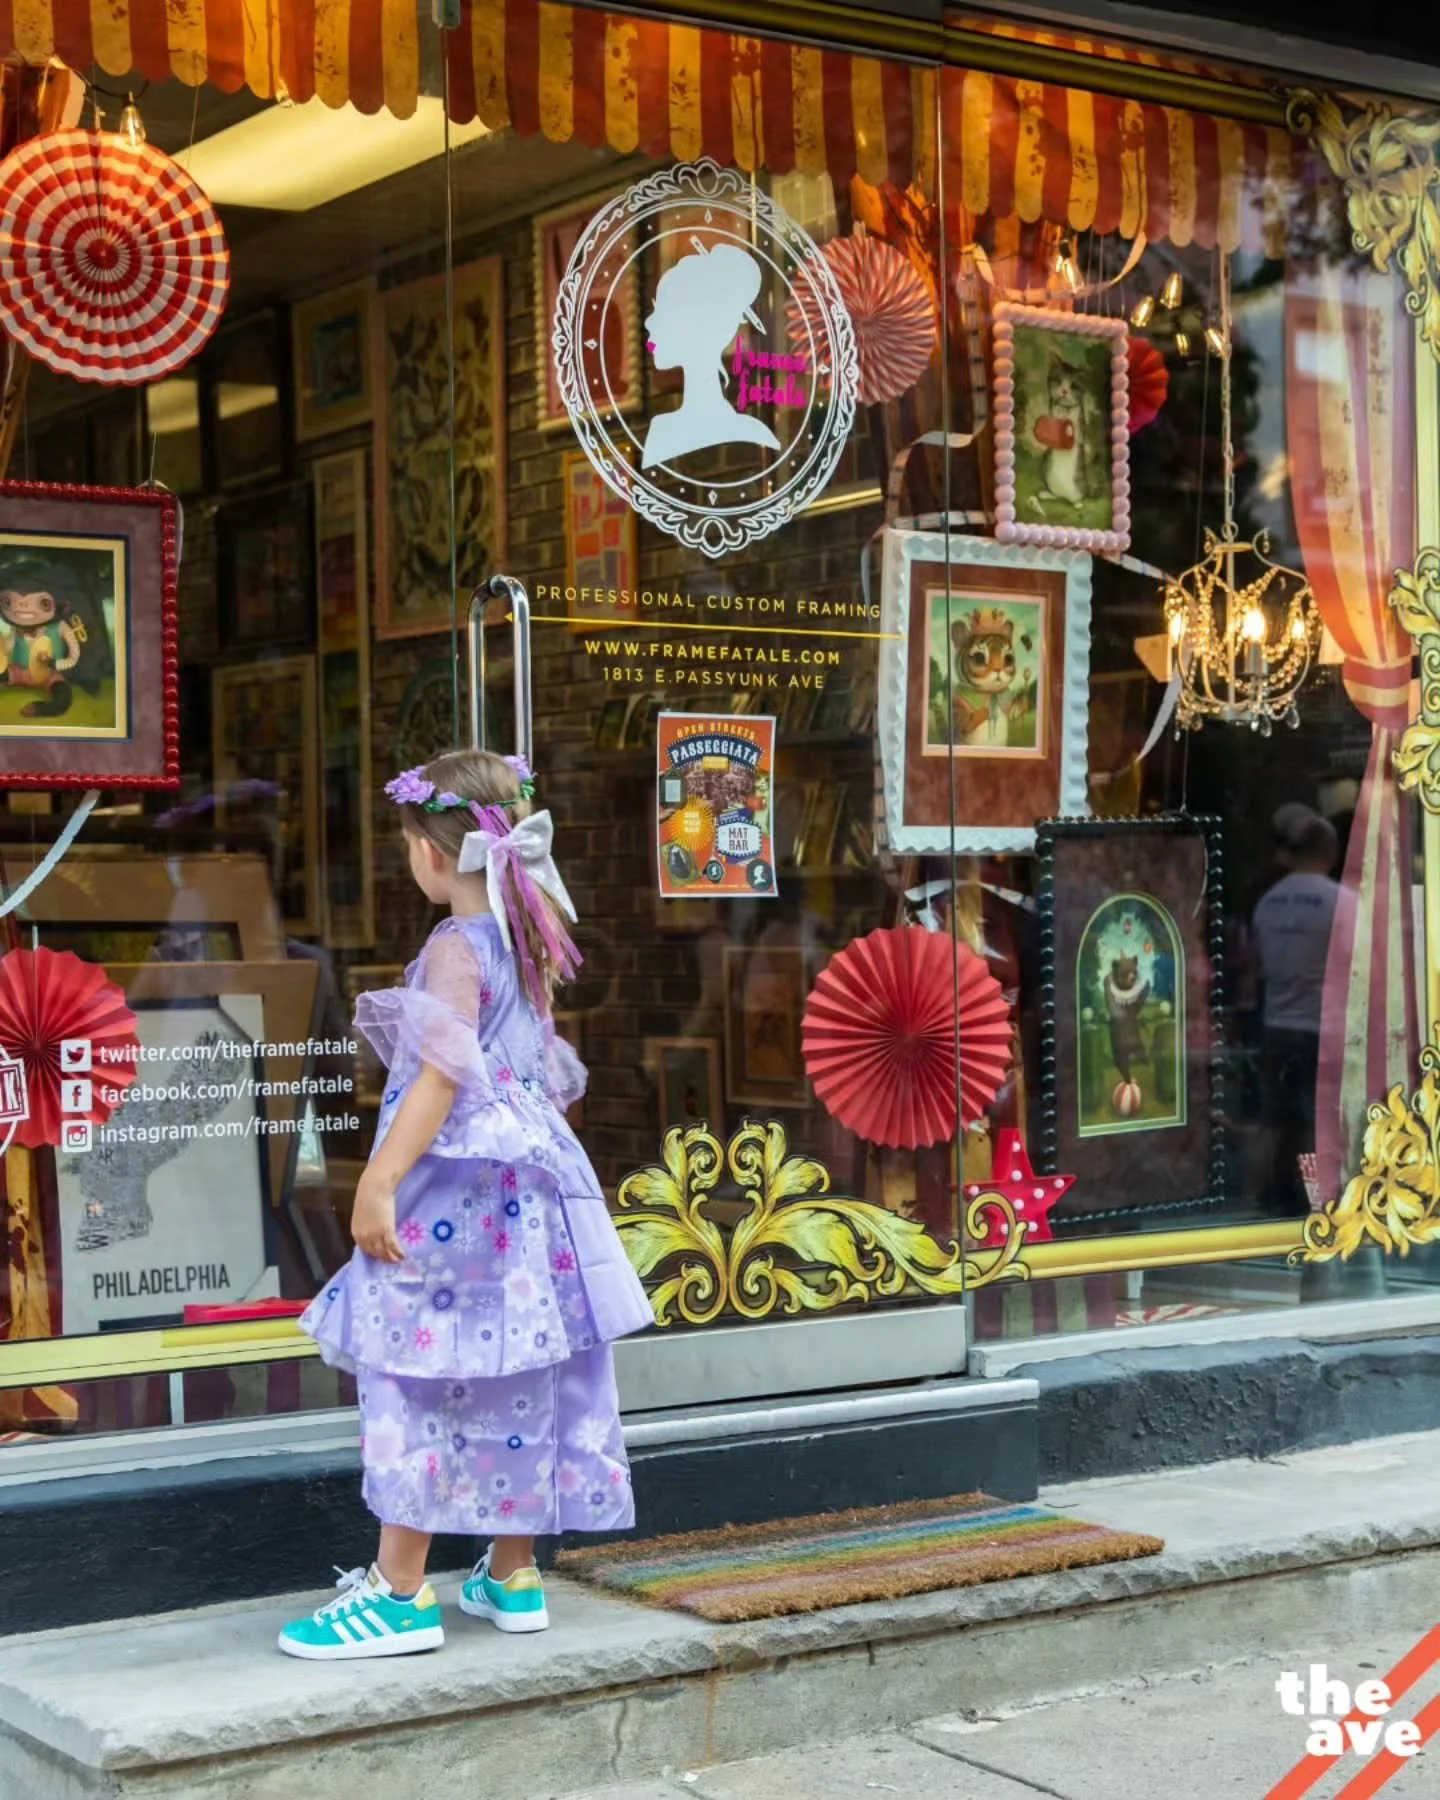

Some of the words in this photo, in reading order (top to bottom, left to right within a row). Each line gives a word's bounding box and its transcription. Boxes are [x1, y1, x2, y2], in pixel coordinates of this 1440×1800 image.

[736, 368, 807, 412] fatale
[536, 585, 695, 608] PROFESSIONAL
[707, 595, 786, 613] CUSTOM
[797, 601, 881, 618] FRAMING
[584, 640, 841, 666] WWW.FRAMEFATALE.COM
[602, 668, 644, 682] 1813
[655, 671, 779, 688] E.PASSYUNK
[788, 675, 824, 689] AVE
[676, 722, 704, 738] OPEN
[710, 722, 756, 740] STREETS
[671, 739, 759, 765] PASSEGGIATA
[728, 827, 749, 839] MAT
[728, 839, 749, 851] BAR
[100, 1037, 357, 1063] twitter.com/theframefatale
[100, 1075, 353, 1103] facebook.com/framefatale
[100, 1112, 360, 1144] instagram.com/framefatale
[93, 1263, 231, 1300] PHILADELPHIA
